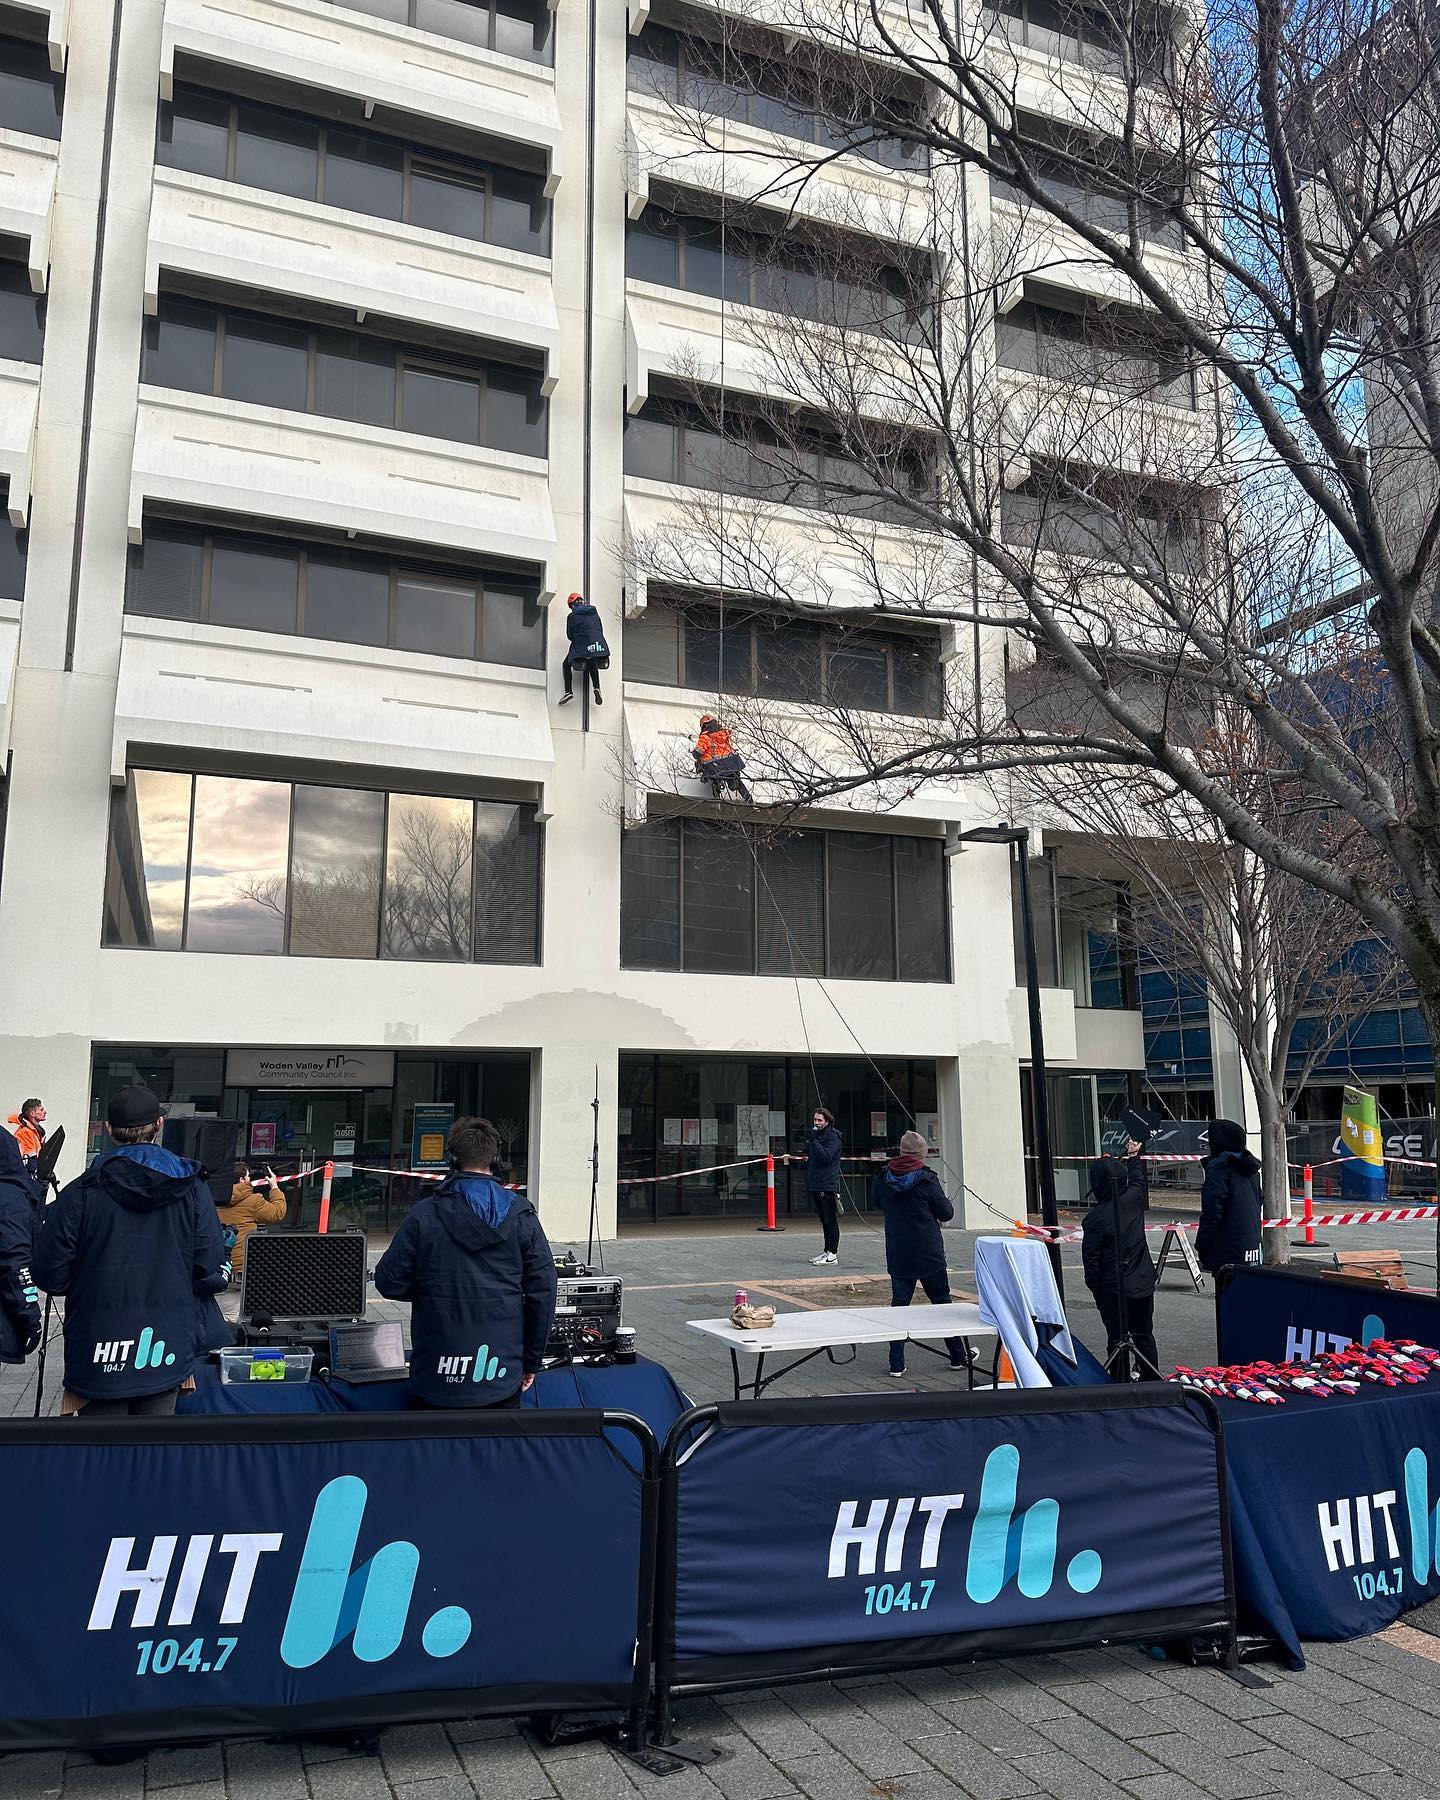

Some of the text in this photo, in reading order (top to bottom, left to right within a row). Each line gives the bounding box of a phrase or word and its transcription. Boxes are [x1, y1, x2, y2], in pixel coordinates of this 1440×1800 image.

[258, 1070, 309, 1079] Community
[311, 1070, 342, 1079] Council
[259, 1061, 324, 1071] Woden Valley
[1245, 1249, 1259, 1262] HIT
[93, 1339, 135, 1363] HIT
[1285, 1325, 1353, 1362] HIT
[103, 1362, 126, 1373] 104.7
[437, 1355, 473, 1375] HIT
[445, 1375, 466, 1384] 104.7
[827, 1493, 965, 1579] HIT
[1317, 1490, 1401, 1572] HIT
[86, 1532, 284, 1631] HIT
[1352, 1566, 1404, 1601] 104.7
[864, 1579, 936, 1616] 104.7
[136, 1637, 239, 1675] 104.7
